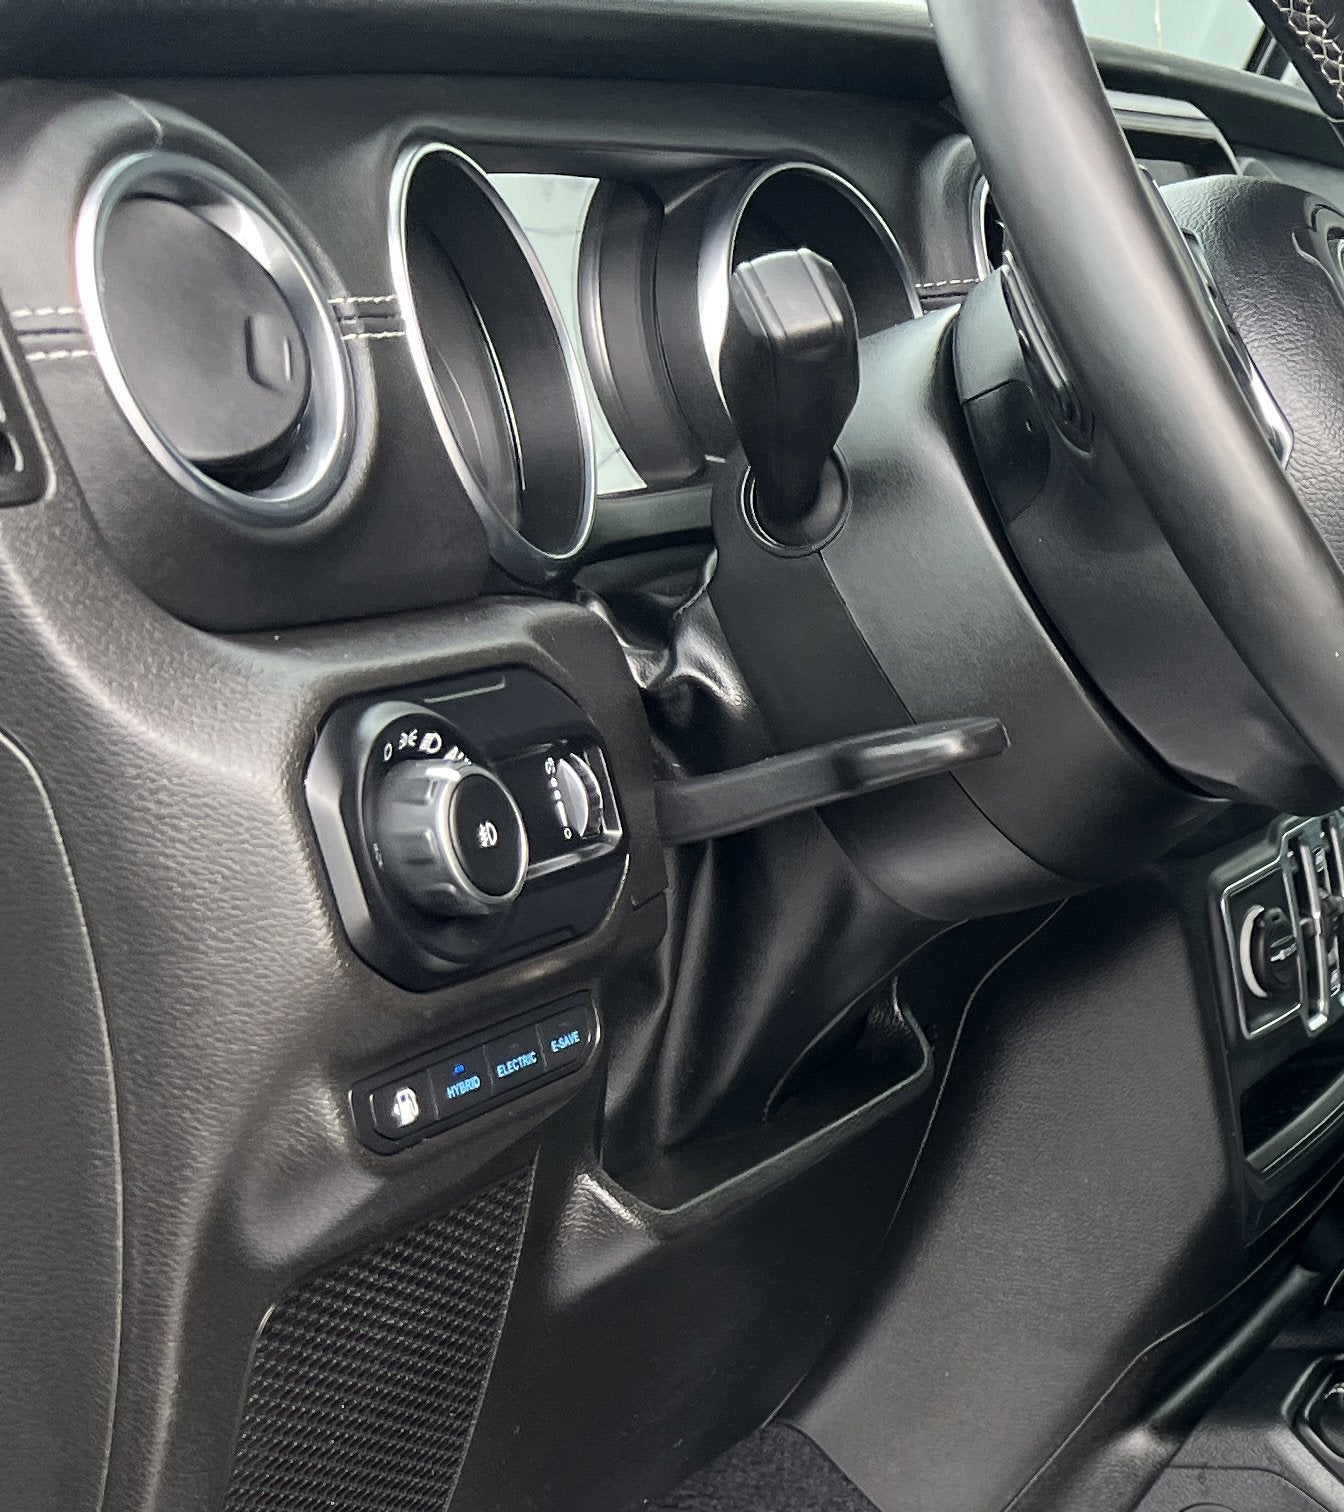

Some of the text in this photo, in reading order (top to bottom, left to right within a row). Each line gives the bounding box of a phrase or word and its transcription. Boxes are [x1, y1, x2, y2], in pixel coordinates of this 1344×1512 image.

[550, 1030, 581, 1053] E-SAVE
[496, 1051, 538, 1078] ELECTRIC
[446, 1075, 481, 1099] HYBRID
